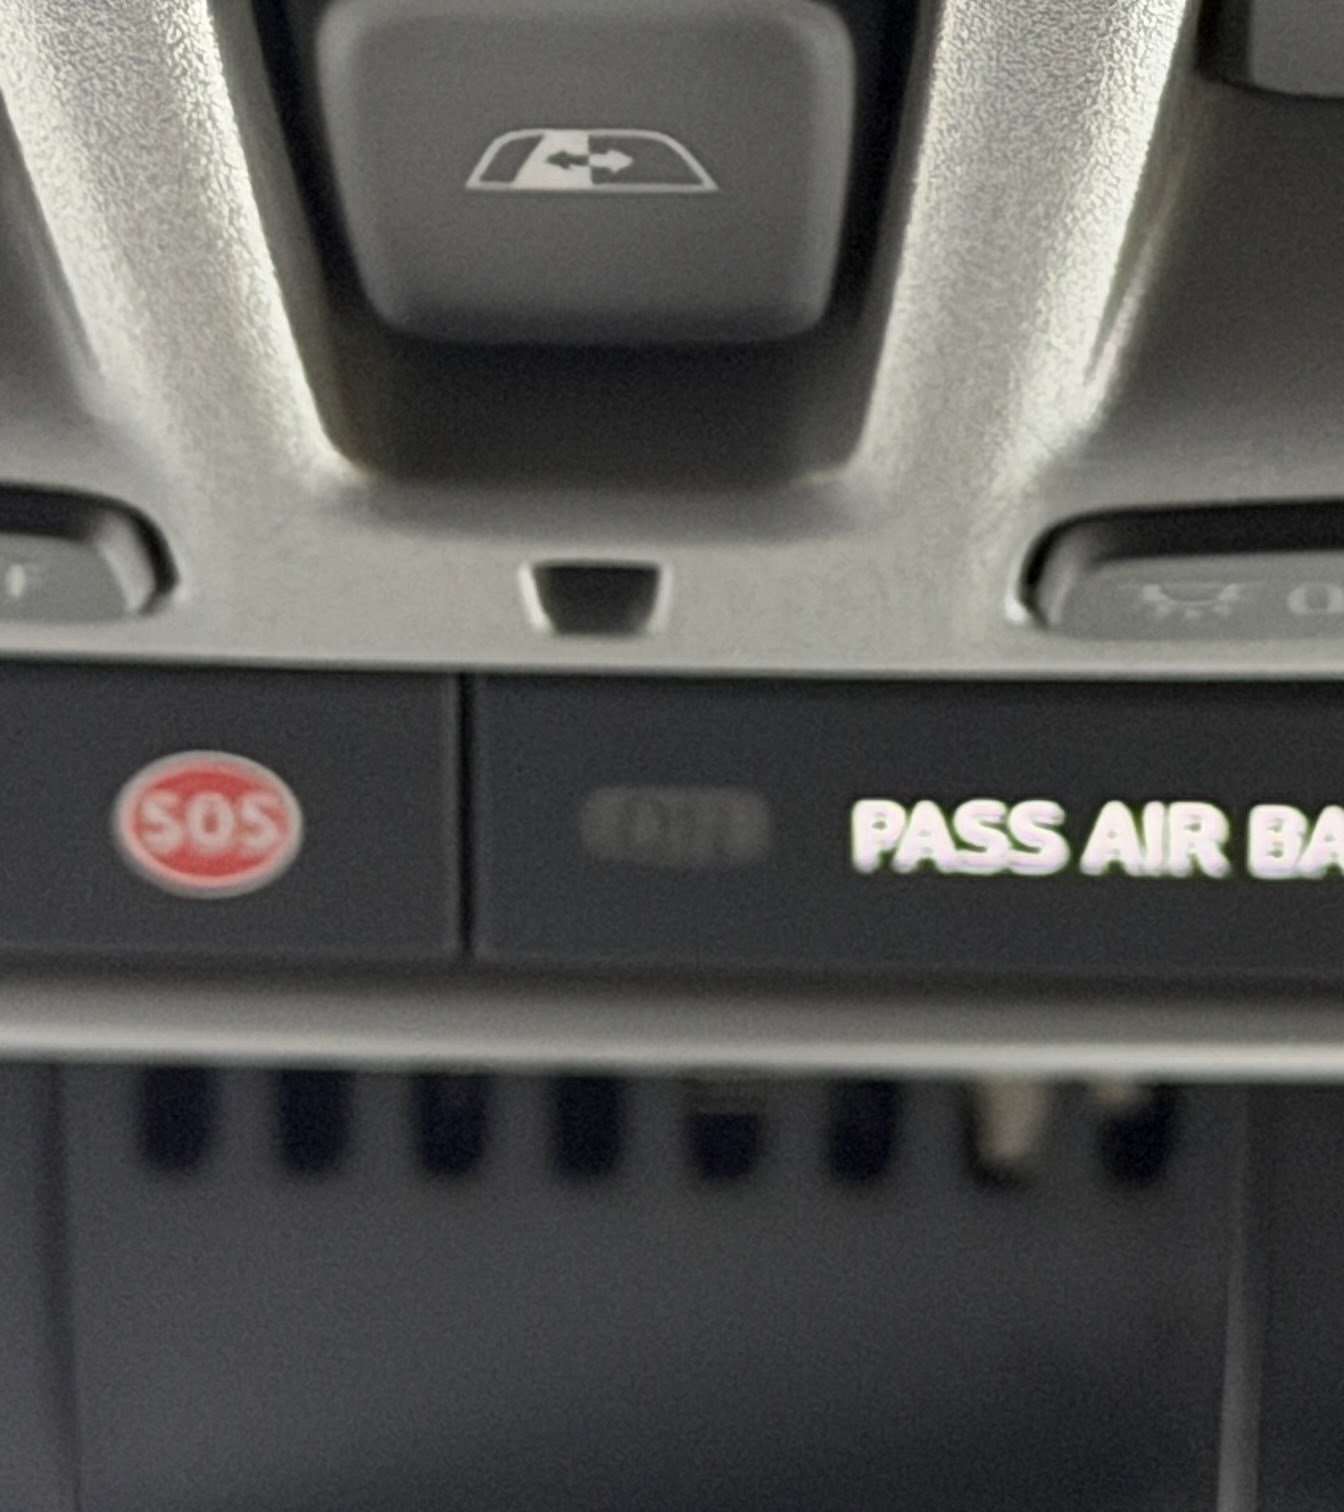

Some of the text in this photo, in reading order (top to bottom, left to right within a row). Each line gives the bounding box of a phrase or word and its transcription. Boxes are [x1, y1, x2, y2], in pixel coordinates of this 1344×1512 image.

[140, 790, 285, 855] SOS
[851, 798, 1071, 876] PASS
[1079, 799, 1231, 879] AIR
